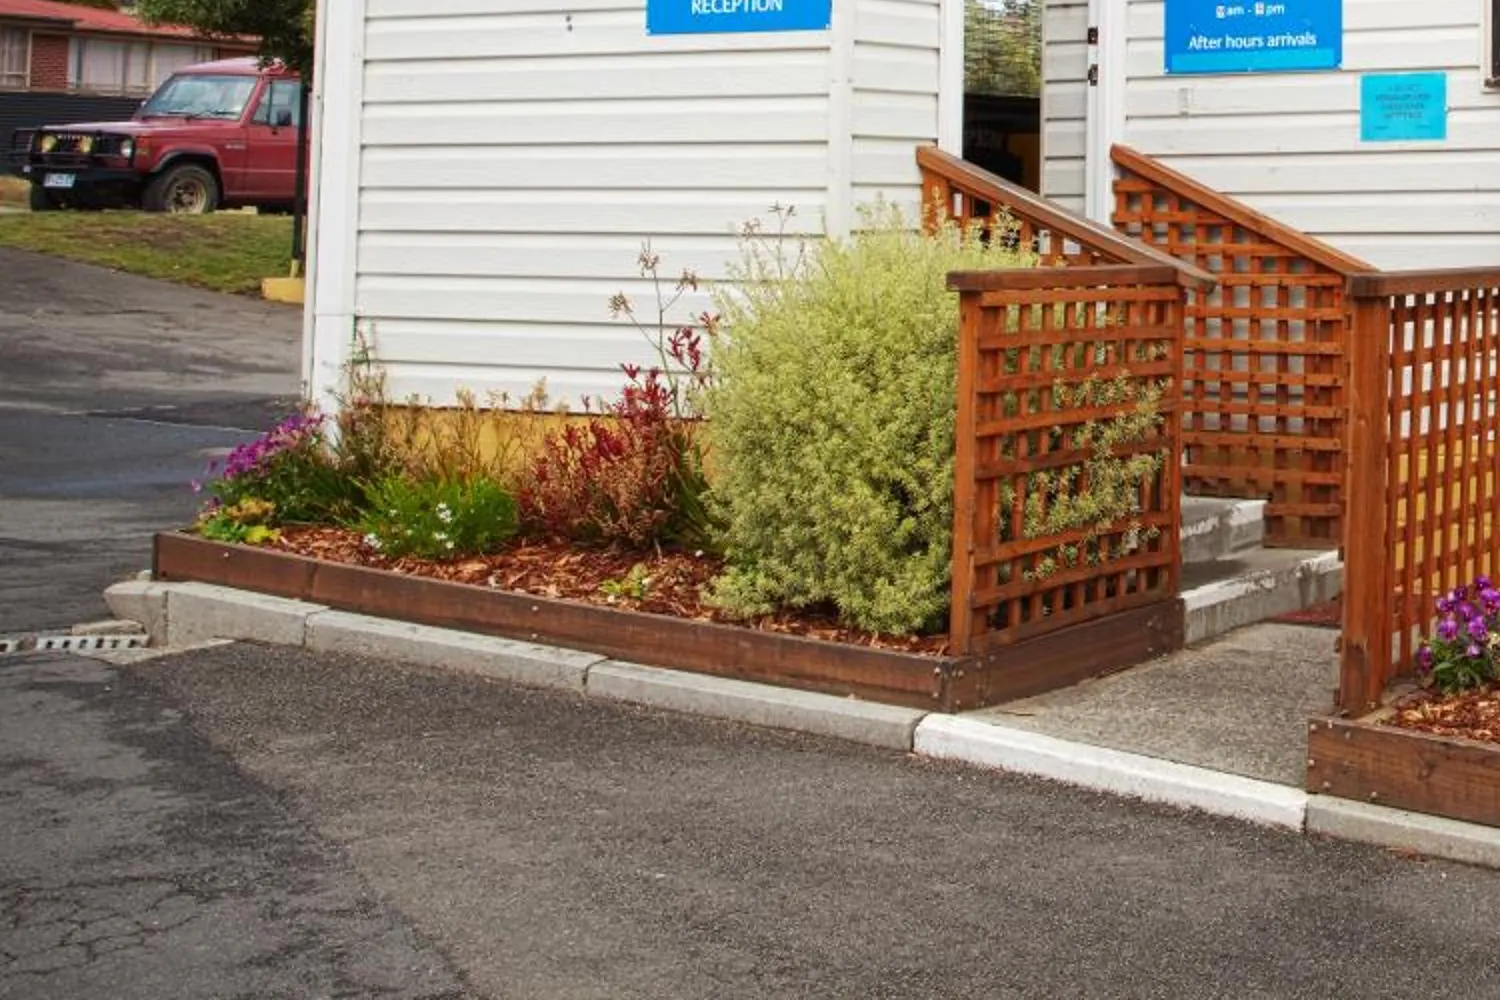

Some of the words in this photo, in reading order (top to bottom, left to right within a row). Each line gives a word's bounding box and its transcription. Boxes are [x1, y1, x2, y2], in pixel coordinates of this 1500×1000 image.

[1189, 34, 1222, 50] After
[1225, 34, 1264, 48] hours
[1267, 31, 1317, 47] arrivals
